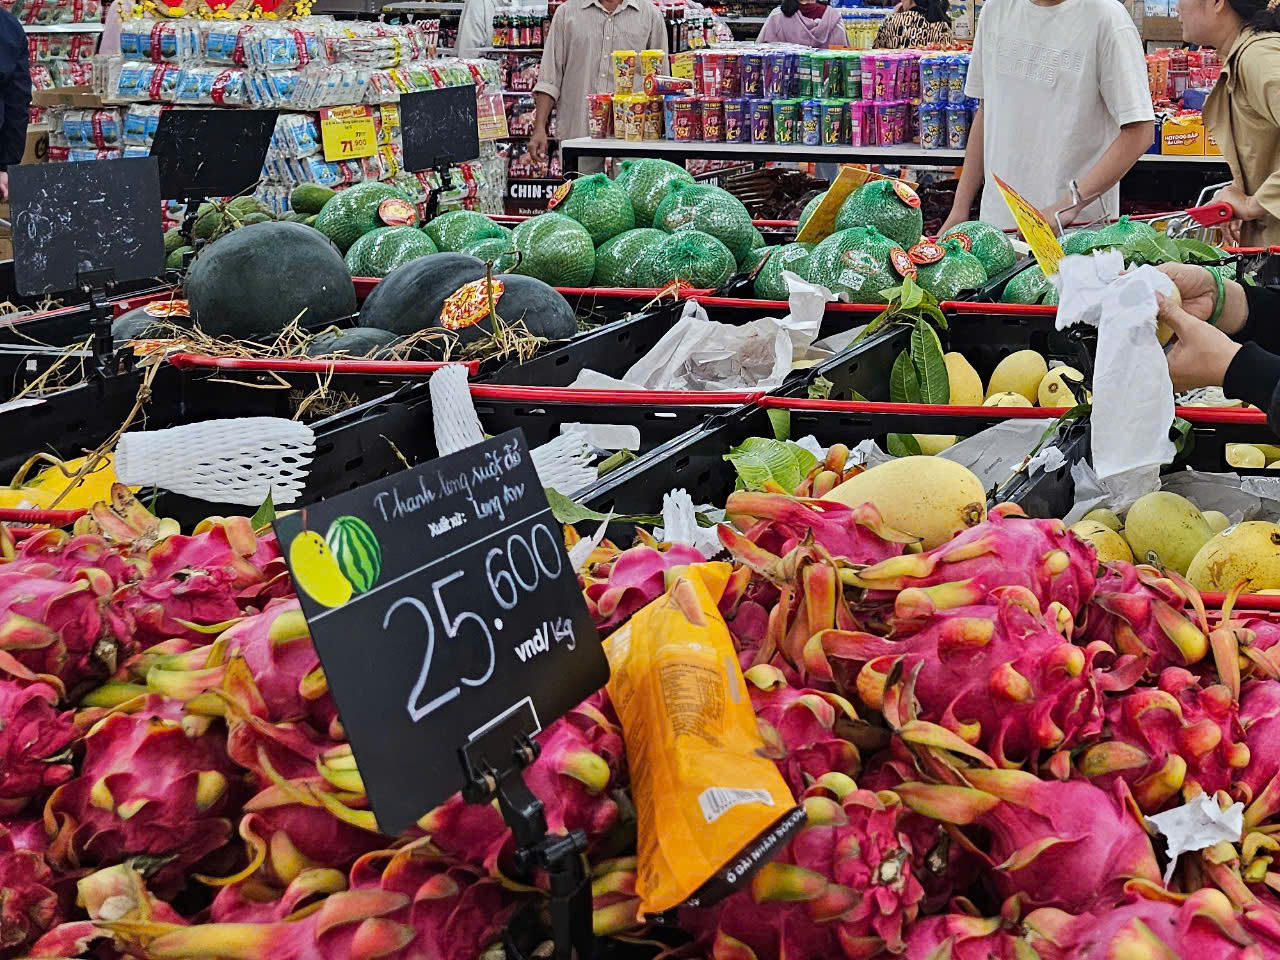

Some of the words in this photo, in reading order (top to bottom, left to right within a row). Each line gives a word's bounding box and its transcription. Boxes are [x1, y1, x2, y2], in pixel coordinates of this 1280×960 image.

[341, 140, 353, 153] 71
[373, 474, 436, 522] Thanh
[438, 470, 474, 501] long
[503, 437, 522, 470] đỏ
